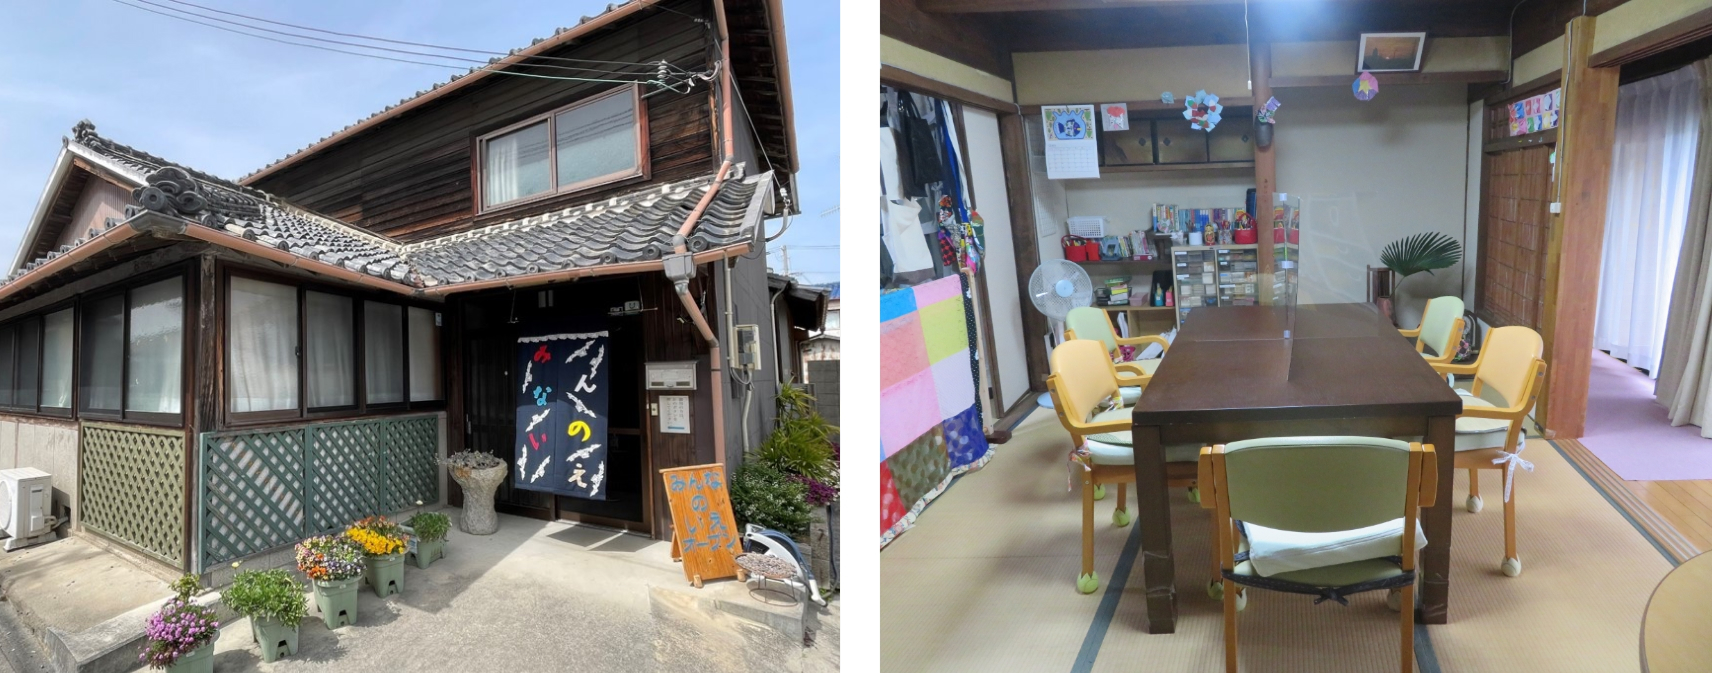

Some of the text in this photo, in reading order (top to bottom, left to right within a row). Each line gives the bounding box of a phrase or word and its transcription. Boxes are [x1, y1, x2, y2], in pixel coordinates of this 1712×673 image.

[671, 472, 722, 491] みんな
[692, 495, 707, 512] の
[683, 532, 736, 553] オープン
